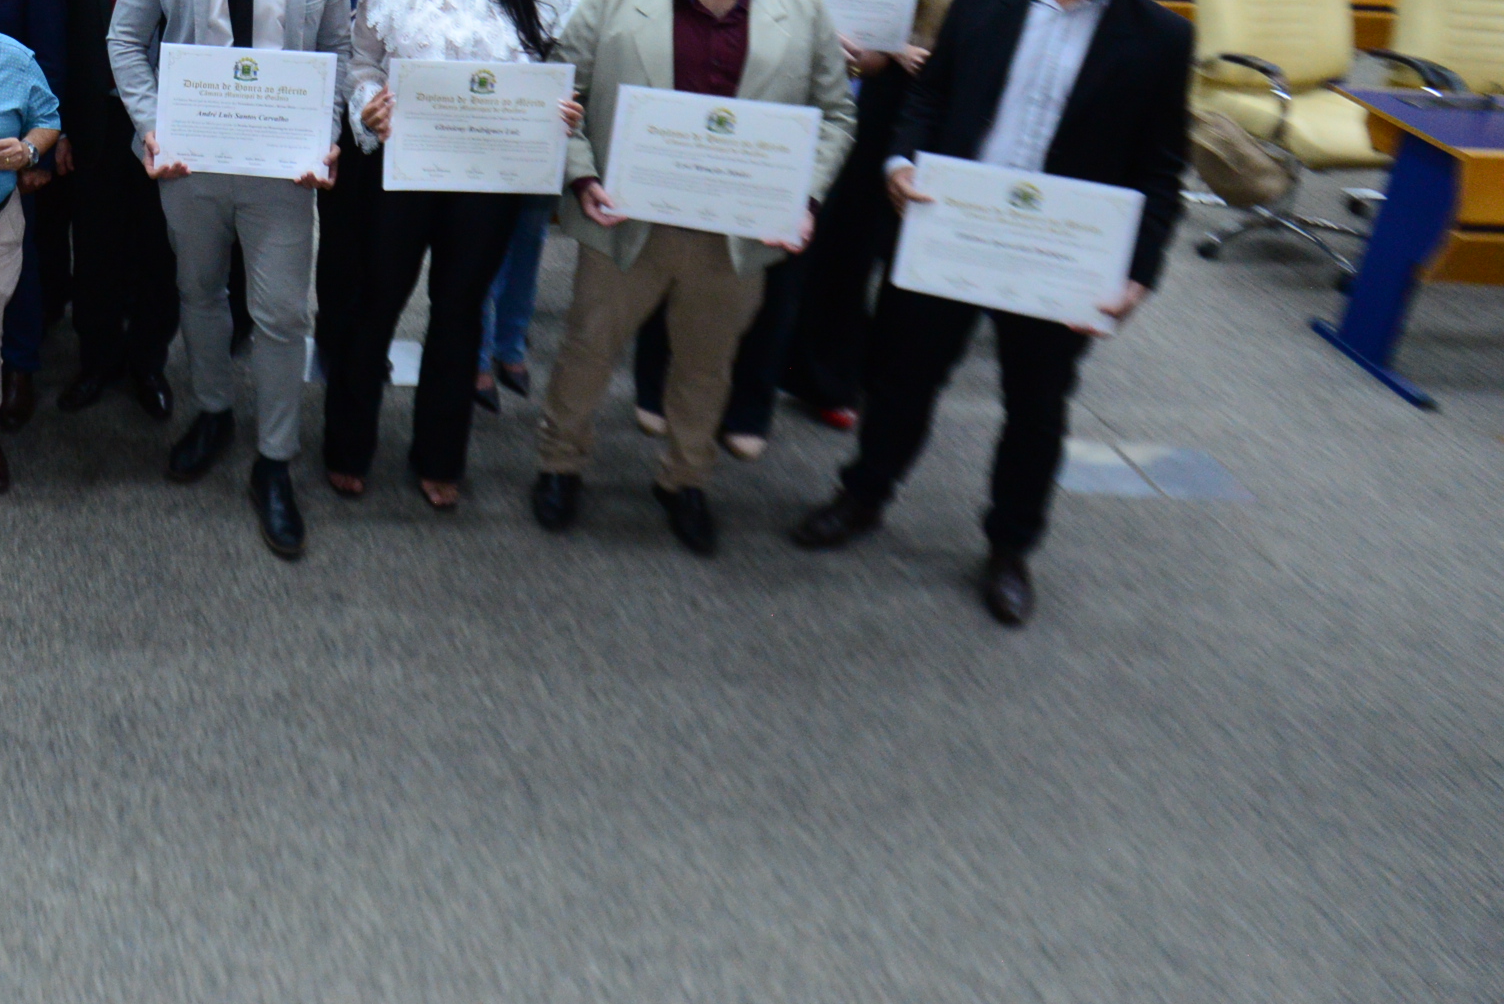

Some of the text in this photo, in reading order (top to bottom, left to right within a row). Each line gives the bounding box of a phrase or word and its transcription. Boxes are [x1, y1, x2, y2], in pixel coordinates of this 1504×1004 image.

[183, 80, 219, 90] Diploma
[222, 82, 232, 90] de
[235, 83, 262, 93] Honra
[277, 86, 308, 96] Mérito
[259, 114, 289, 122] Carvalho
